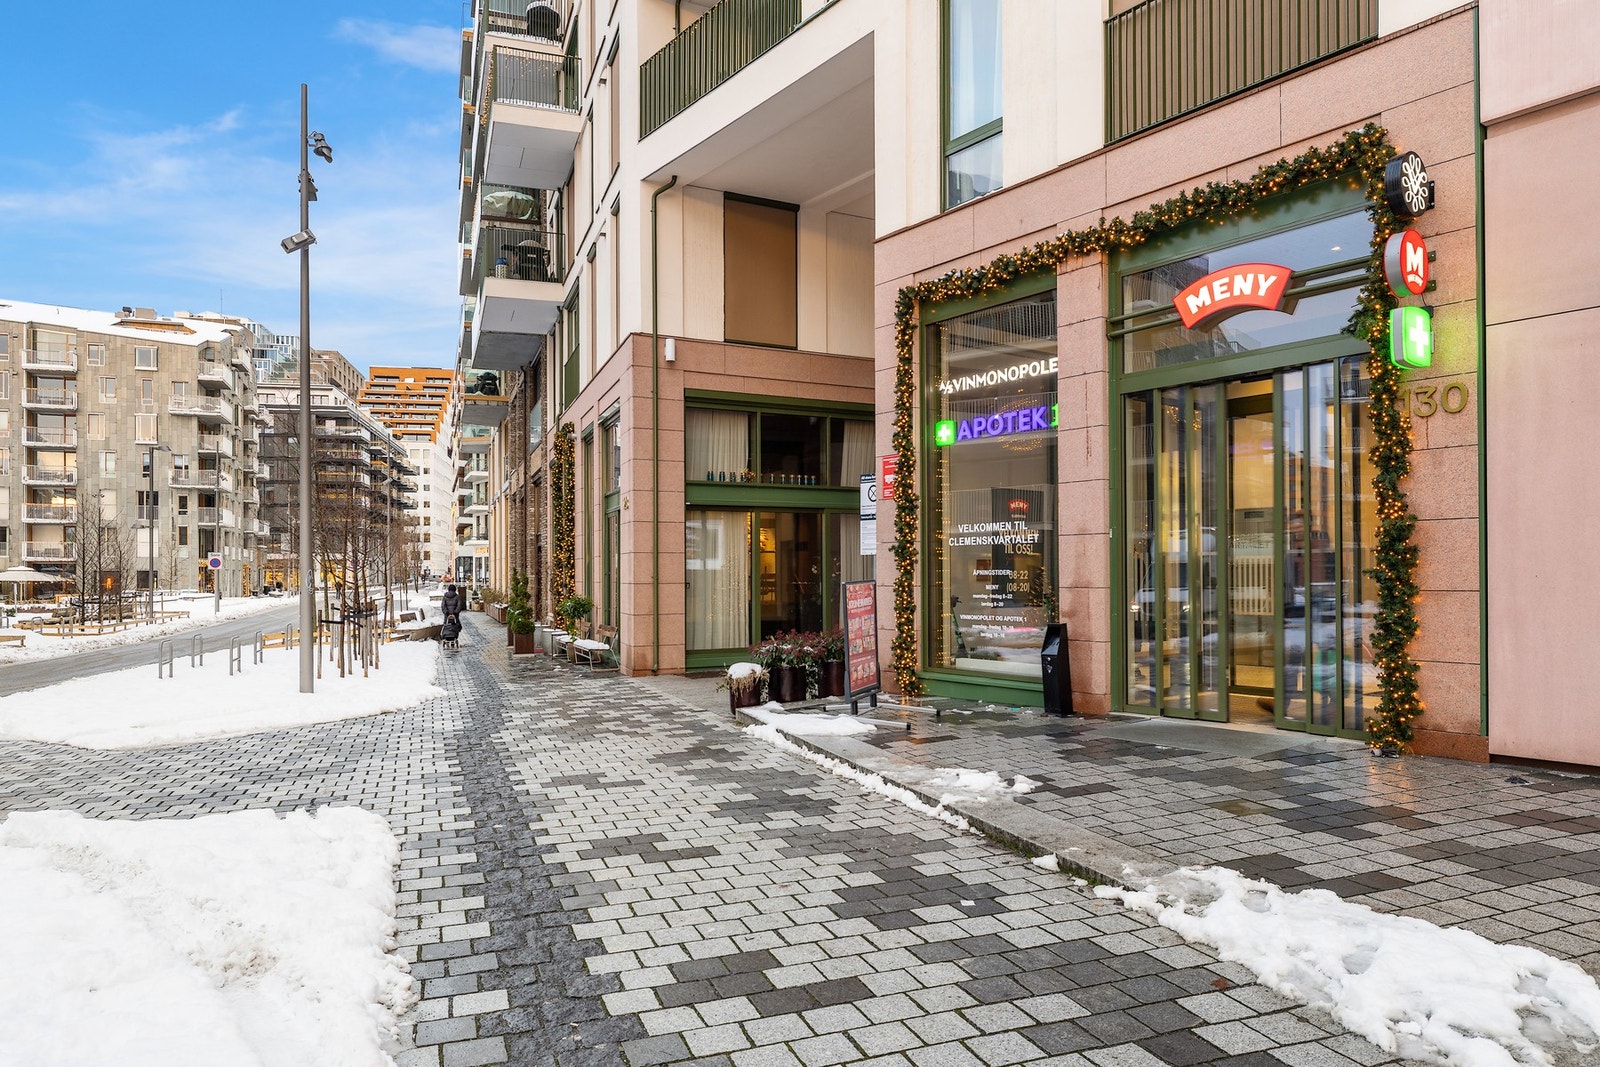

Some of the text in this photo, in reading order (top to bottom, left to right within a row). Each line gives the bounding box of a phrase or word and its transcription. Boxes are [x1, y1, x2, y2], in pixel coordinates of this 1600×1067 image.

[1406, 241, 1424, 278] M
[1185, 273, 1278, 315] MENY
[1399, 381, 1469, 418] 130
[957, 406, 1048, 441] APOTEK
[948, 534, 1039, 546] CLEMENSKVARTALET
[958, 521, 1028, 533] VELKOMMEN TIL
[1004, 543, 1014, 554] TIL
